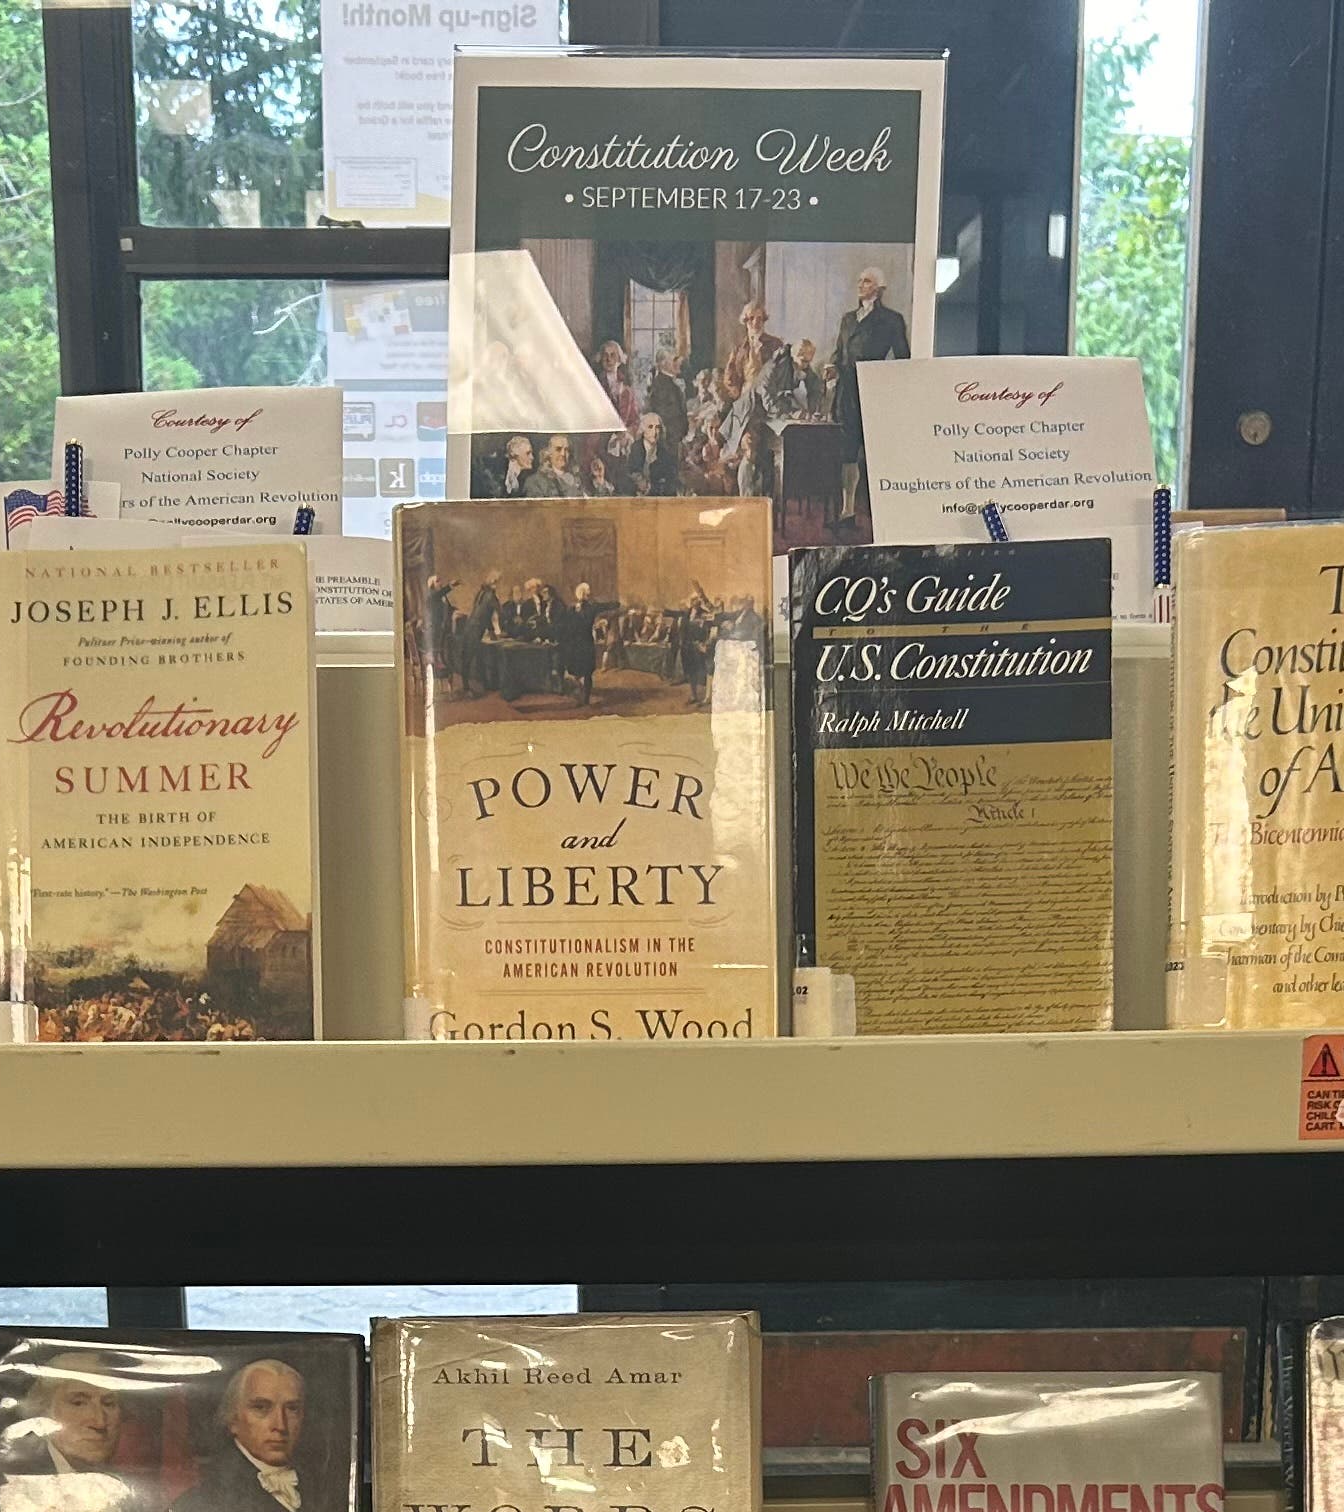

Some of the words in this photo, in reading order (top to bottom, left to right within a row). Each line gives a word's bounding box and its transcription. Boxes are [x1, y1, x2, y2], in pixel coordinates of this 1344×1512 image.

[507, 122, 740, 174] Constitution
[755, 126, 893, 176] Week
[581, 186, 728, 210] SEPTEMBER
[735, 188, 802, 211] 17-23
[954, 382, 1034, 409] Courtesy
[1037, 381, 1064, 407] of
[933, 424, 969, 438] Polly
[974, 423, 1025, 438] Cooper
[1030, 420, 1085, 435] Chapter
[953, 450, 1014, 464] National
[1017, 448, 1070, 462] Society
[879, 478, 952, 493] Daughters
[955, 478, 972, 490] of
[975, 477, 997, 490] the
[1001, 475, 1069, 489] American
[1074, 471, 1152, 485] Revolution
[25, 566, 137, 579] NATIONAL
[150, 559, 280, 577] BESTSELLER
[327, 576, 381, 585] PREAMBLE
[814, 575, 897, 622] CQ's
[906, 573, 1011, 613] Guide
[815, 643, 882, 682] U.S.
[890, 637, 1094, 681] Constitution
[6, 688, 301, 759] Revolutionary
[818, 711, 882, 738] Ralph
[885, 707, 971, 731] Mitchell
[55, 762, 254, 794] SUMMER
[467, 762, 705, 821] POWER
[1259, 745, 1314, 819] of
[41, 836, 133, 849] AMERICAN
[141, 833, 271, 848] INDEPENDENCE
[560, 817, 627, 850] and
[455, 864, 725, 908] LIBERTY
[484, 938, 640, 954] CONSTITUTIONALISM
[647, 938, 661, 953] IN
[669, 937, 696, 952] THE
[433, 1367, 509, 1385] Akhil
[525, 1367, 592, 1385] Reed
[604, 1368, 682, 1385] Amar
[462, 1428, 653, 1468] THE
[895, 1418, 987, 1479] SIX
